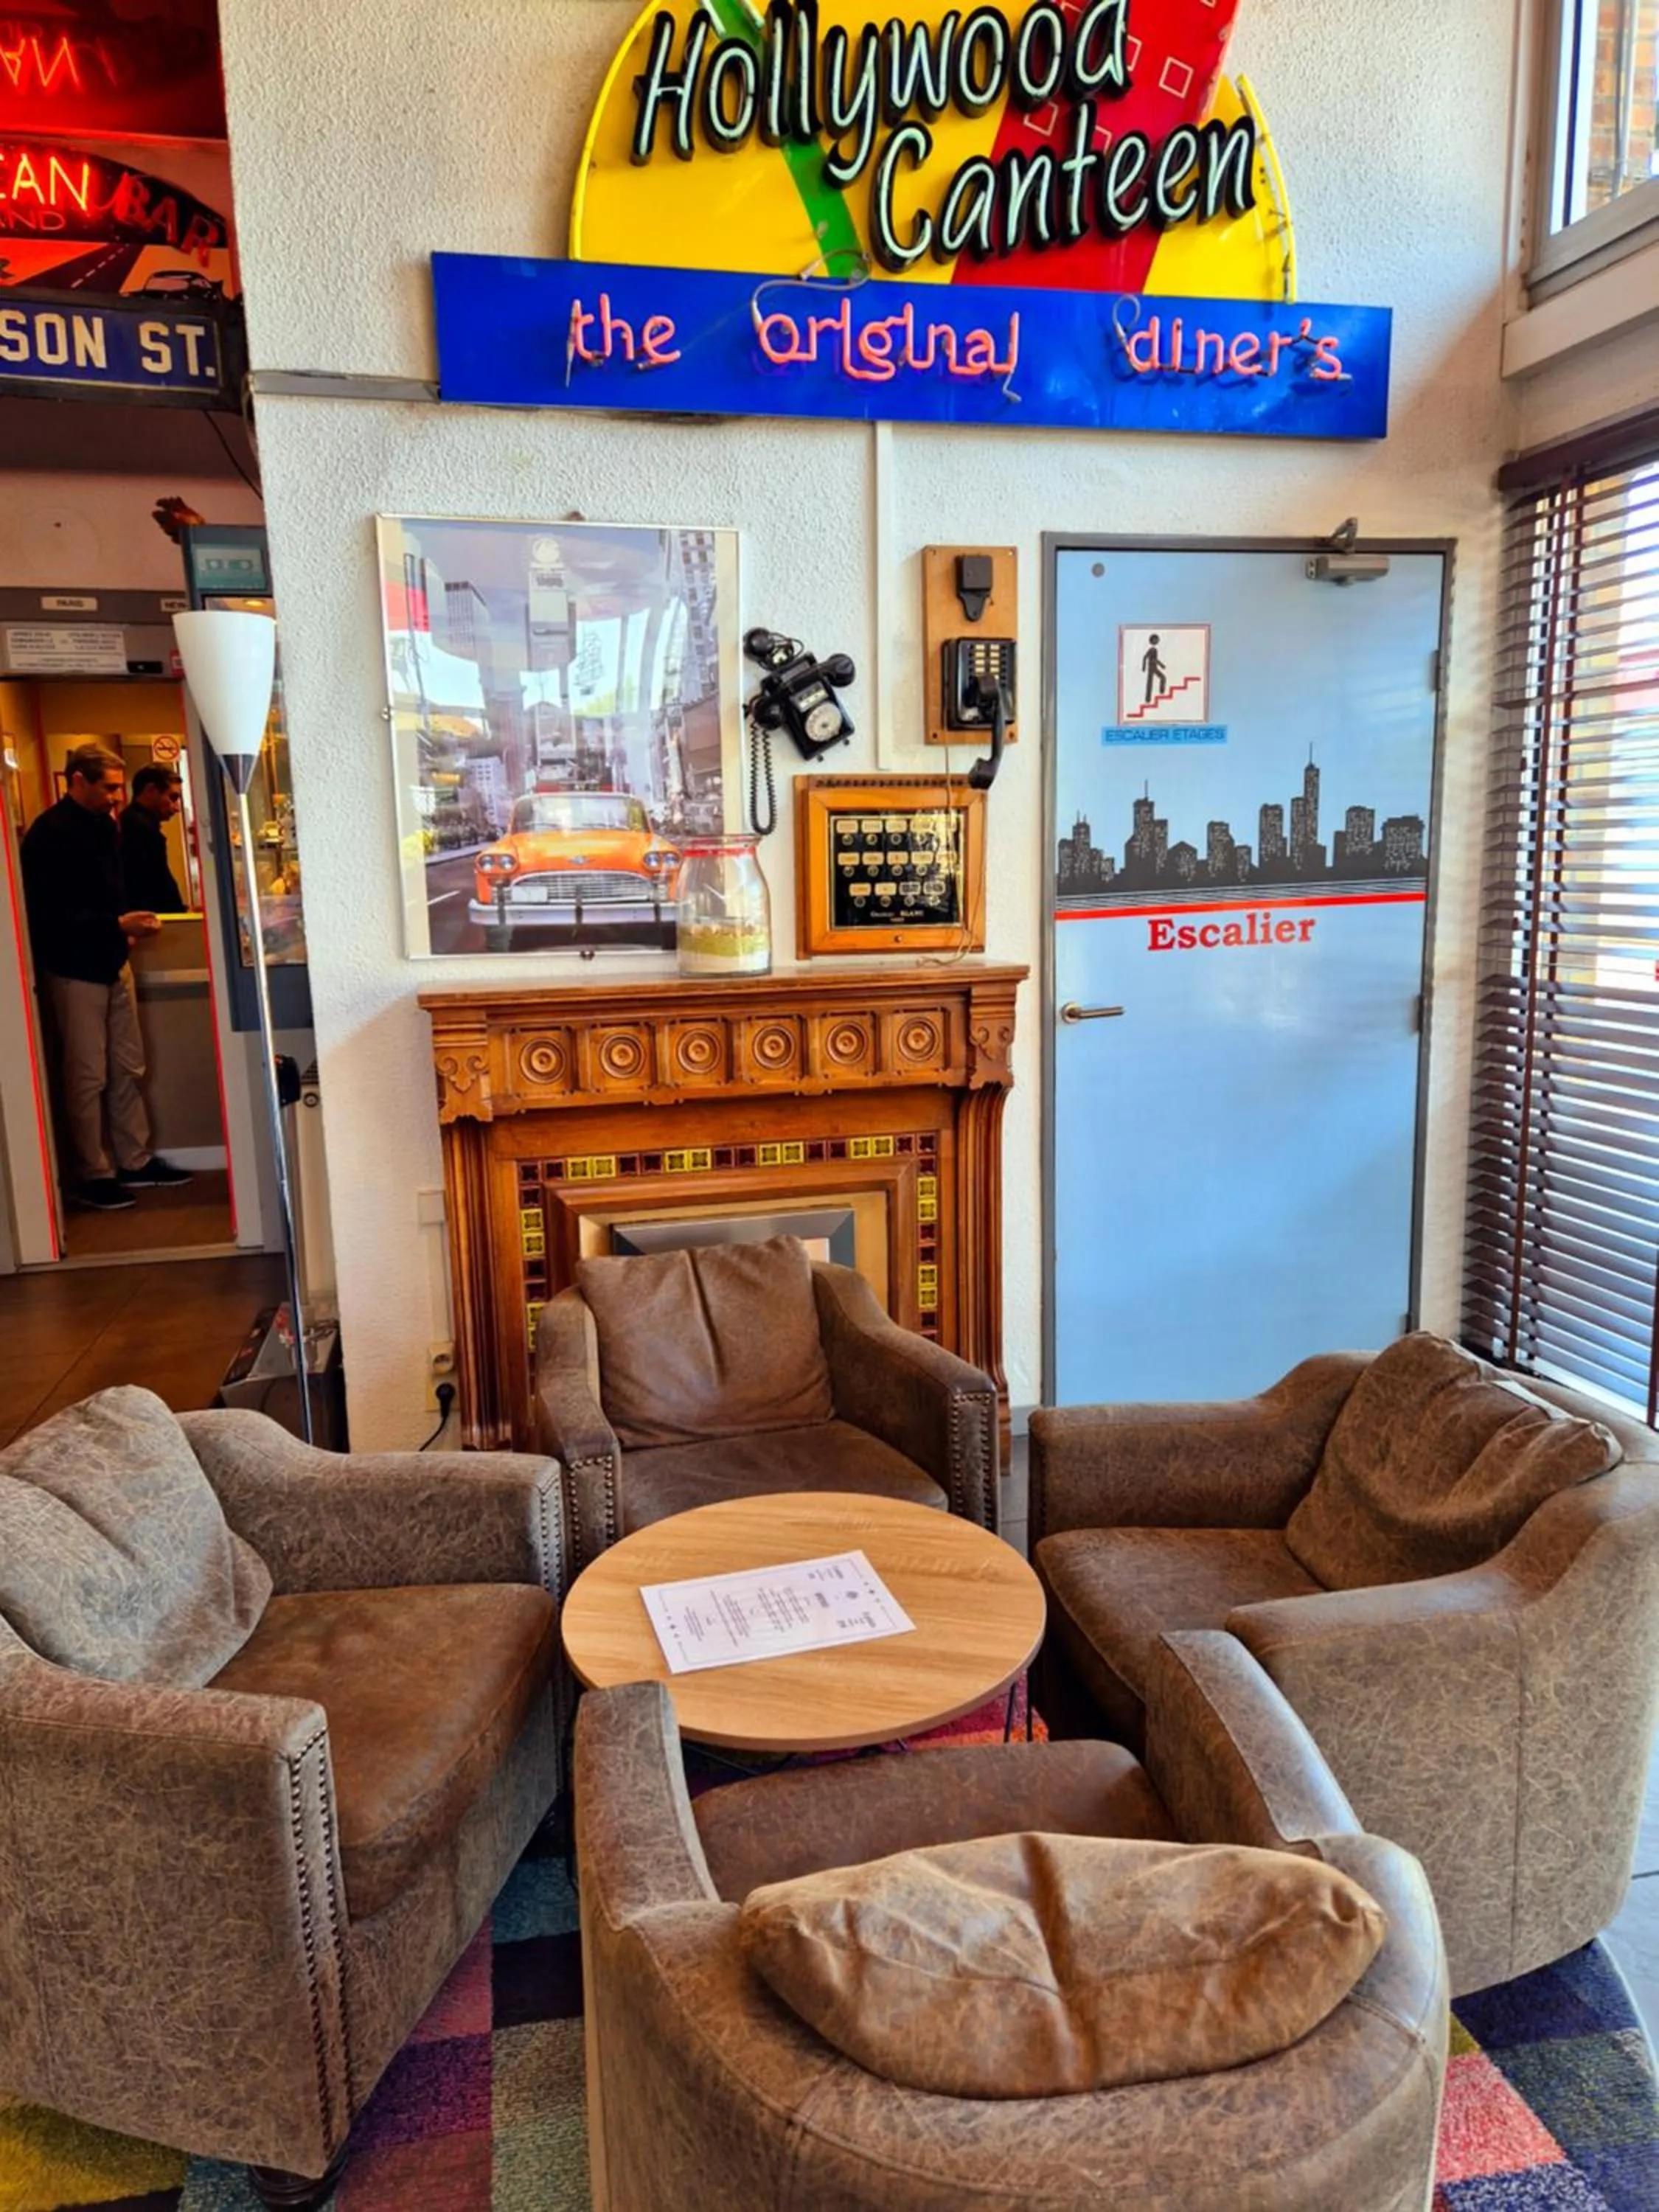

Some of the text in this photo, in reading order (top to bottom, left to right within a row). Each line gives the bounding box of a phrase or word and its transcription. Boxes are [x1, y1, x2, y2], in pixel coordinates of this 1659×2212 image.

[631, 0, 1133, 189] Hollywood
[0, 153, 91, 214] AN
[872, 100, 1257, 274] Canteen
[0, 310, 217, 378] SON ST.
[568, 293, 1342, 382] the original diner's
[1147, 913, 1316, 951] Escalier
